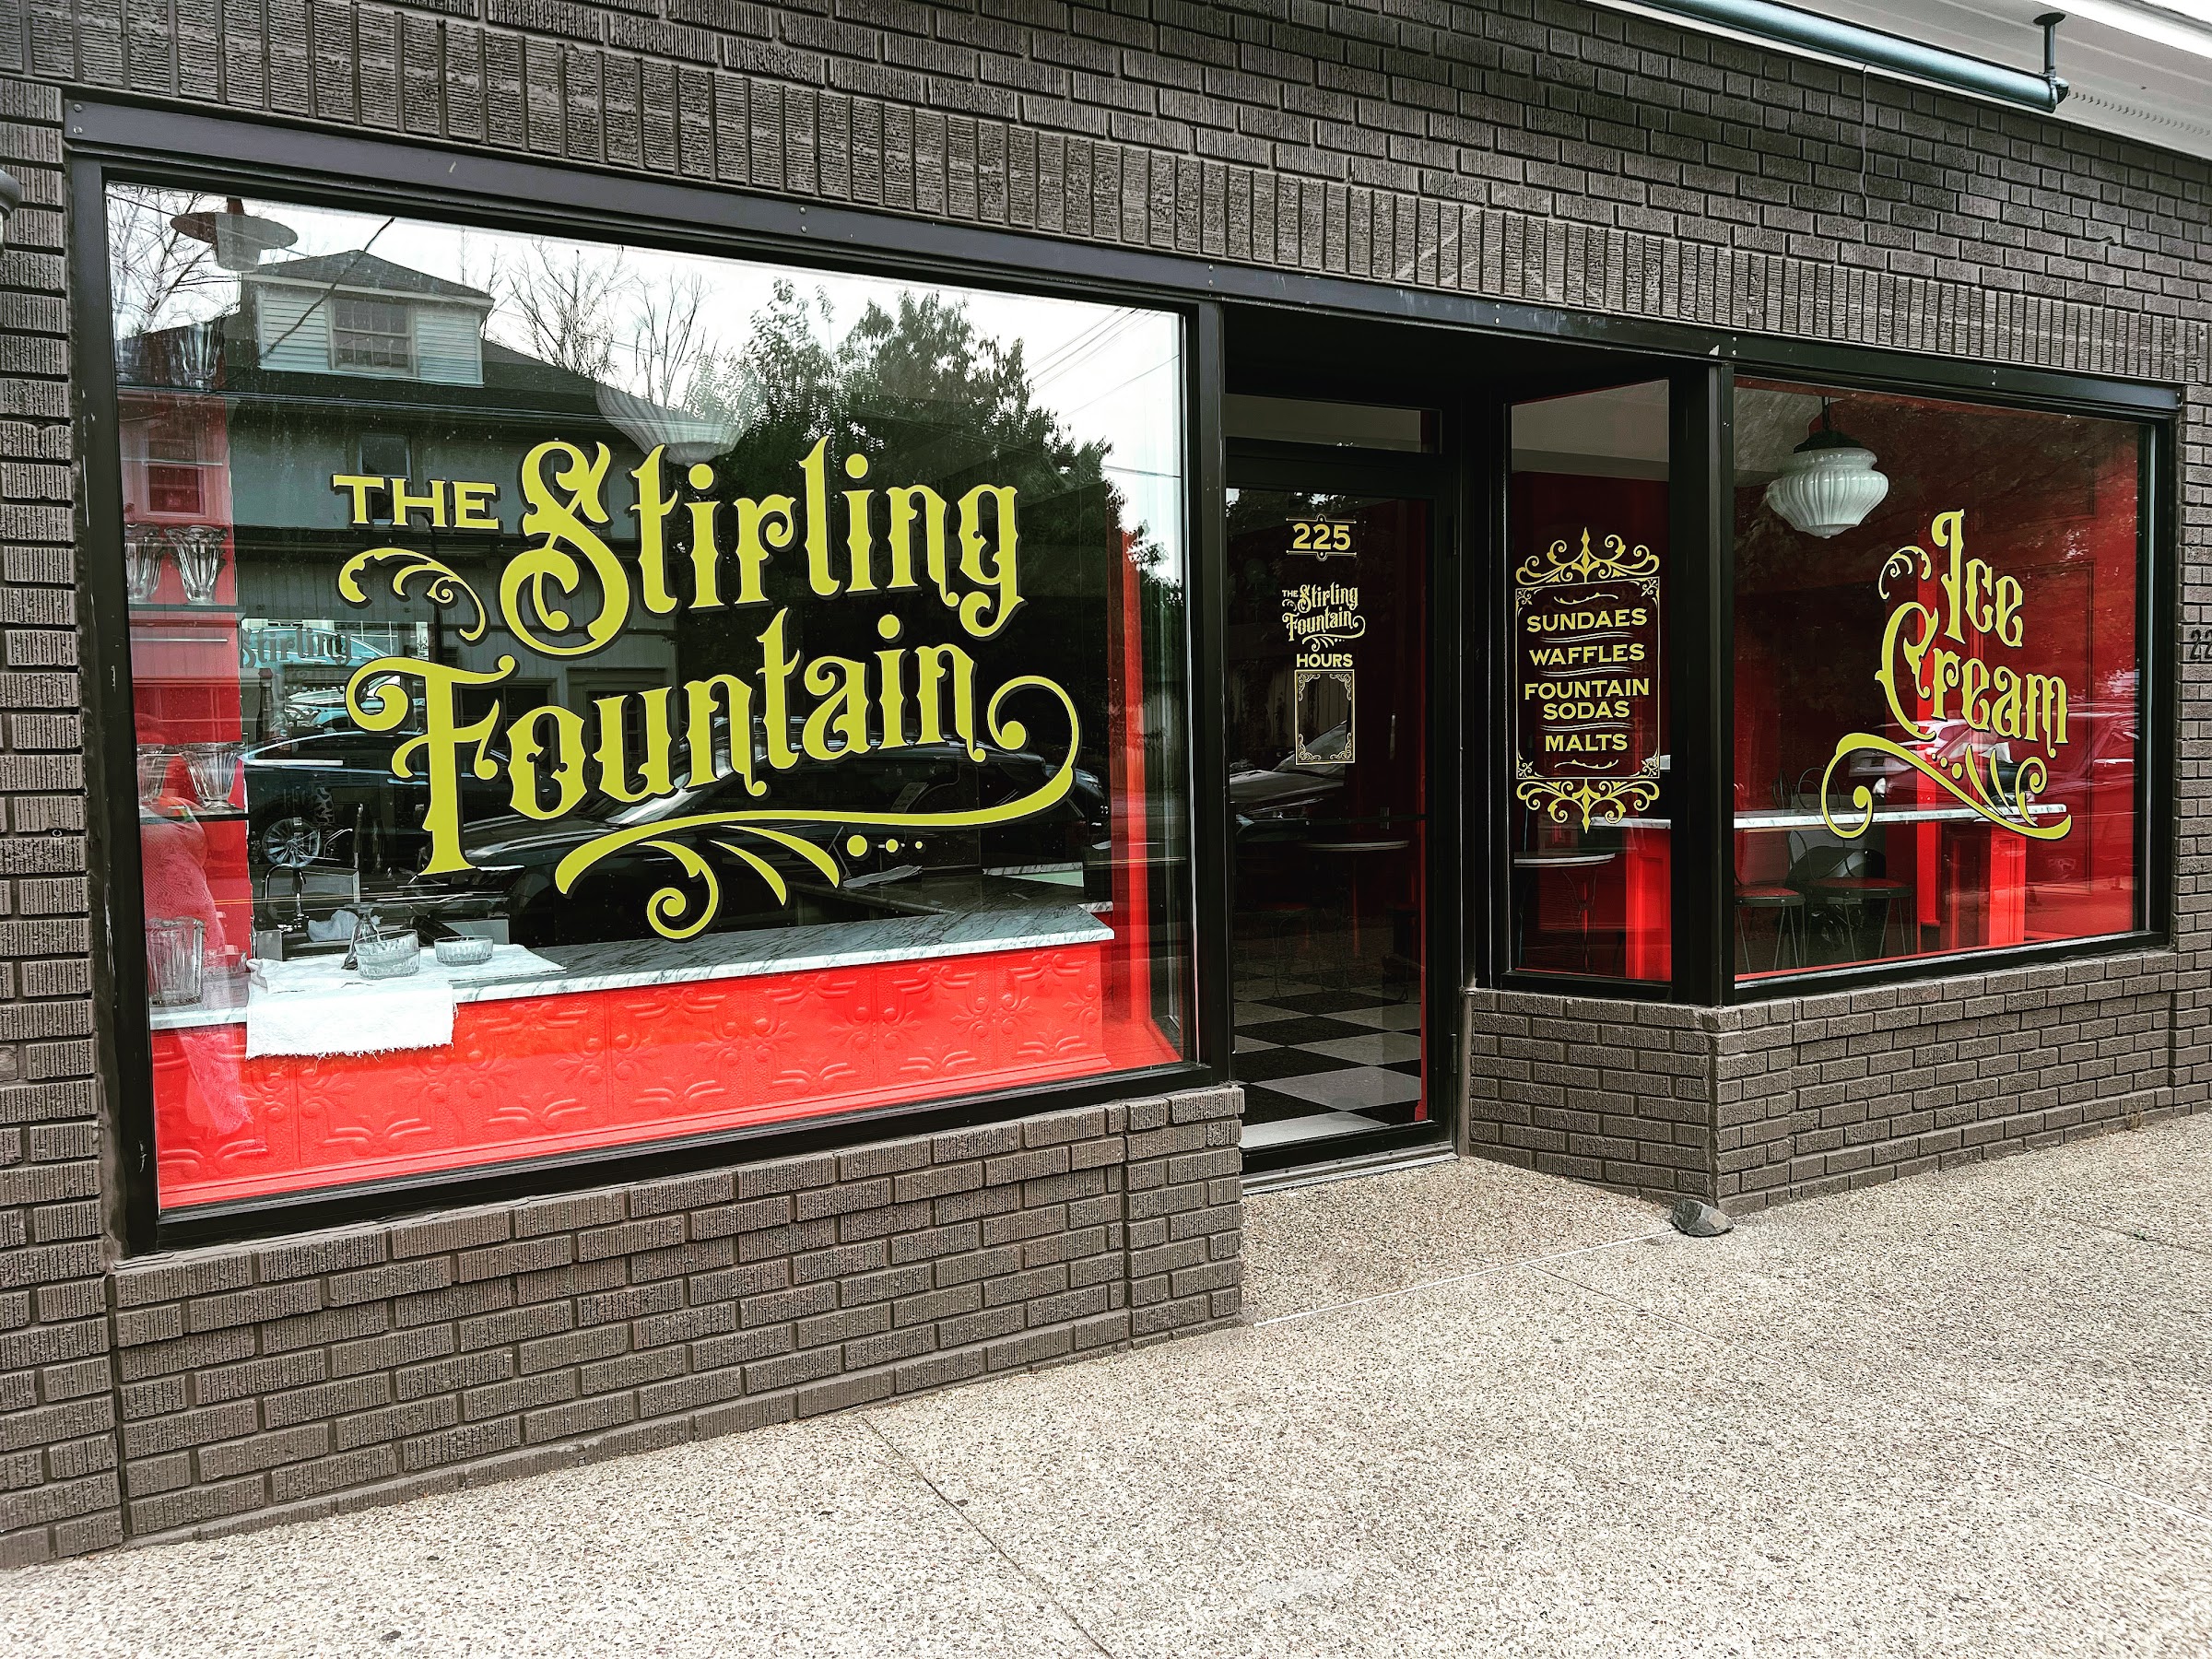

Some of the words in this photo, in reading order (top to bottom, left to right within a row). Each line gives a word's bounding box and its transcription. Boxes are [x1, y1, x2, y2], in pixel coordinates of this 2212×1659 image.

[335, 474, 500, 529] THE
[500, 435, 1023, 655] Stirling
[1292, 523, 1351, 550] 225
[1932, 510, 2024, 647] Ice
[1282, 590, 1298, 598] THE
[1298, 582, 1359, 613] Stirling
[1282, 606, 1354, 641] Fountain
[1526, 607, 1647, 633] SUNDAES
[1296, 653, 1353, 668] HOURS
[1529, 643, 1645, 666] WAFFLES
[1524, 677, 1650, 700] FOUNTAIN
[1875, 601, 2069, 758] Cream
[1543, 700, 1630, 720] SODAS
[346, 606, 988, 876] Fountain
[1545, 734, 1629, 752] MALTS
